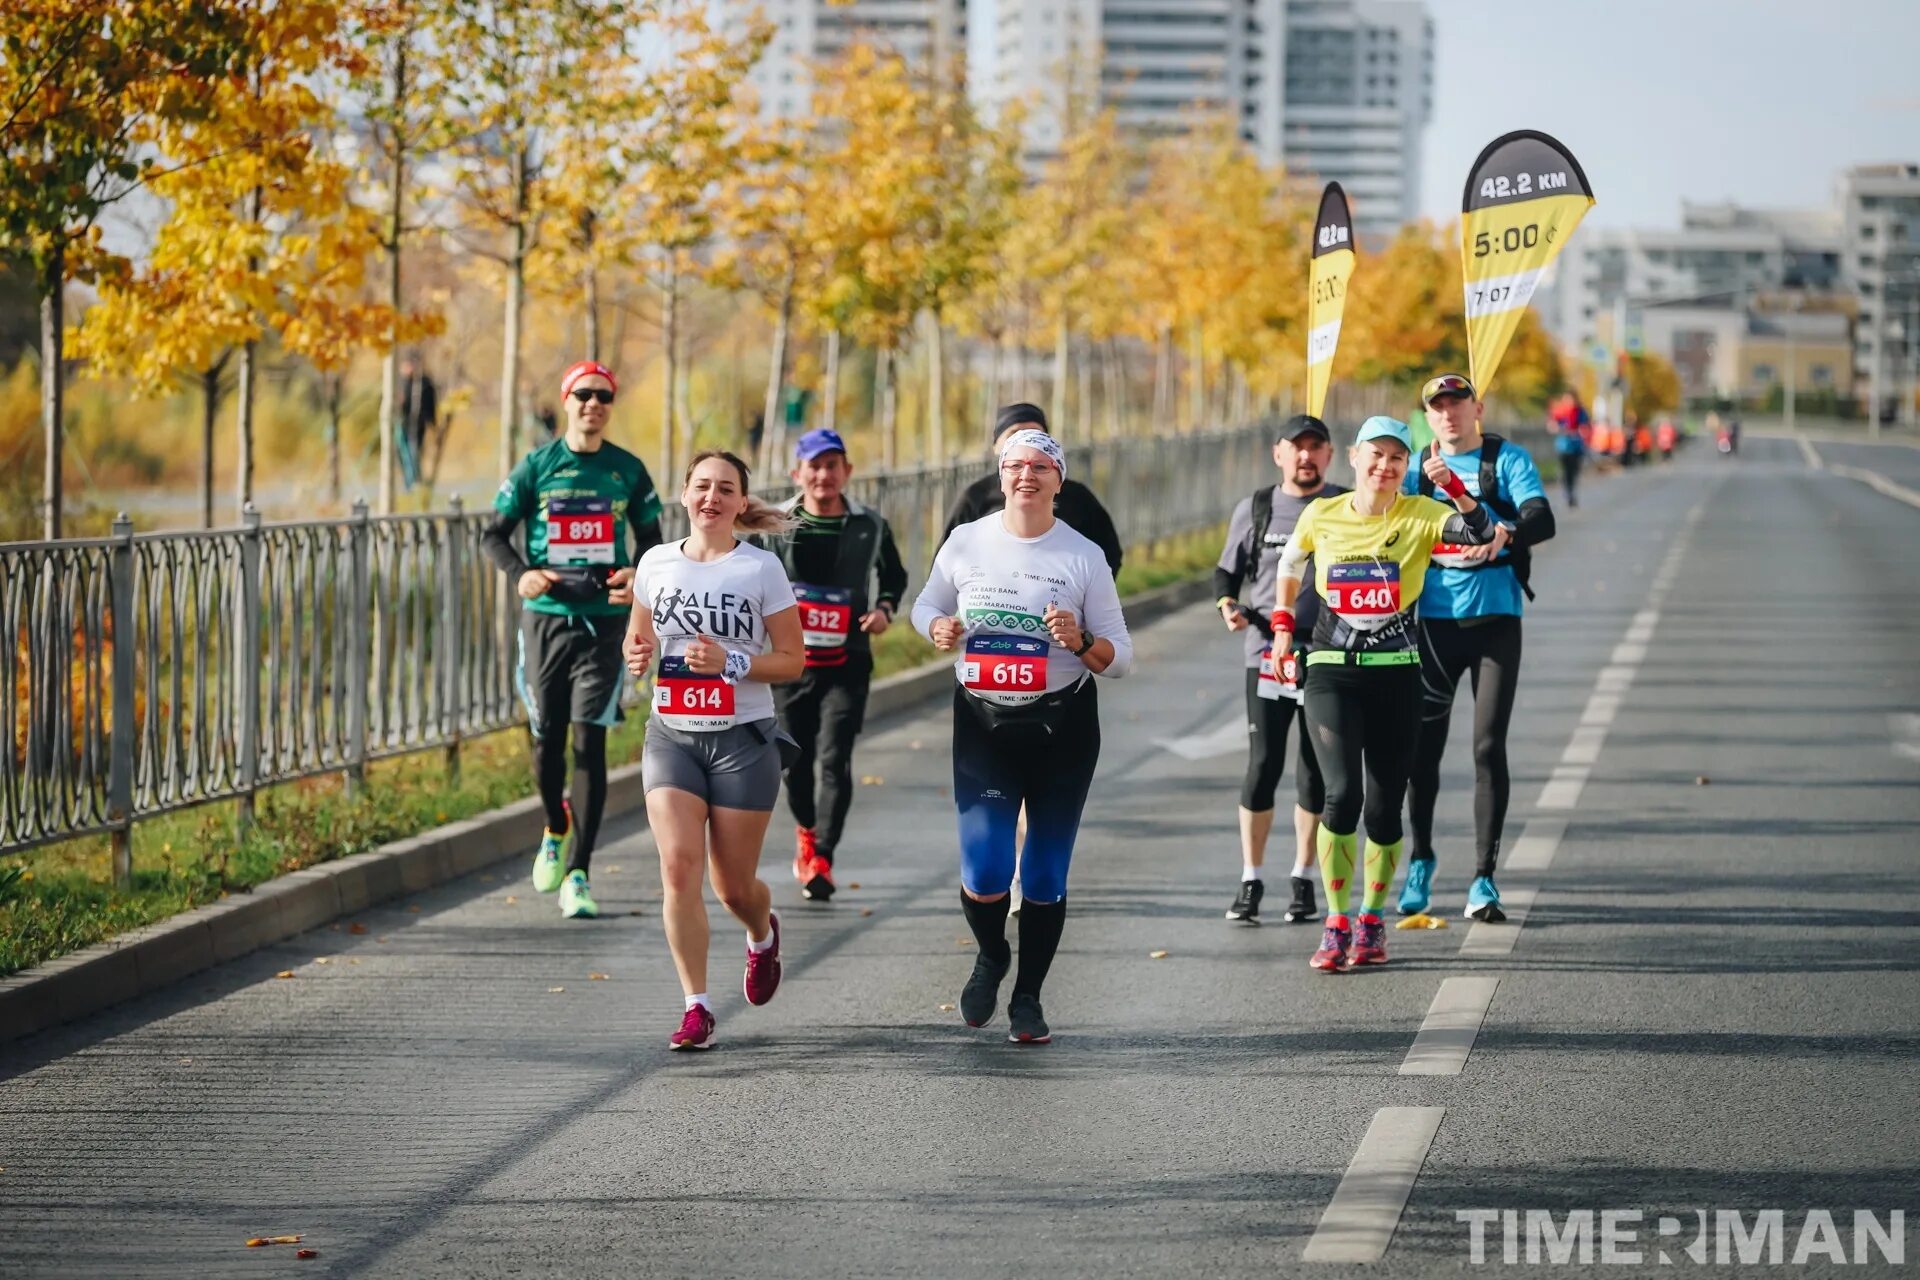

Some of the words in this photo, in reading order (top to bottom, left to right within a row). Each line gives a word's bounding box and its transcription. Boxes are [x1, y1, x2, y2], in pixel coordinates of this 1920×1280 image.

[1480, 172, 1532, 198] 42.2
[1538, 171, 1568, 190] KM
[1474, 223, 1539, 258] 5:00
[569, 521, 603, 540] 891
[683, 592, 753, 615] ALFA
[984, 602, 1028, 612] MARATHON
[1350, 589, 1391, 609] 640
[682, 610, 754, 641] RUN
[807, 608, 840, 629] 512
[968, 667, 974, 677] E
[993, 662, 1034, 685] 615
[661, 692, 668, 701] E
[683, 686, 722, 709] 614
